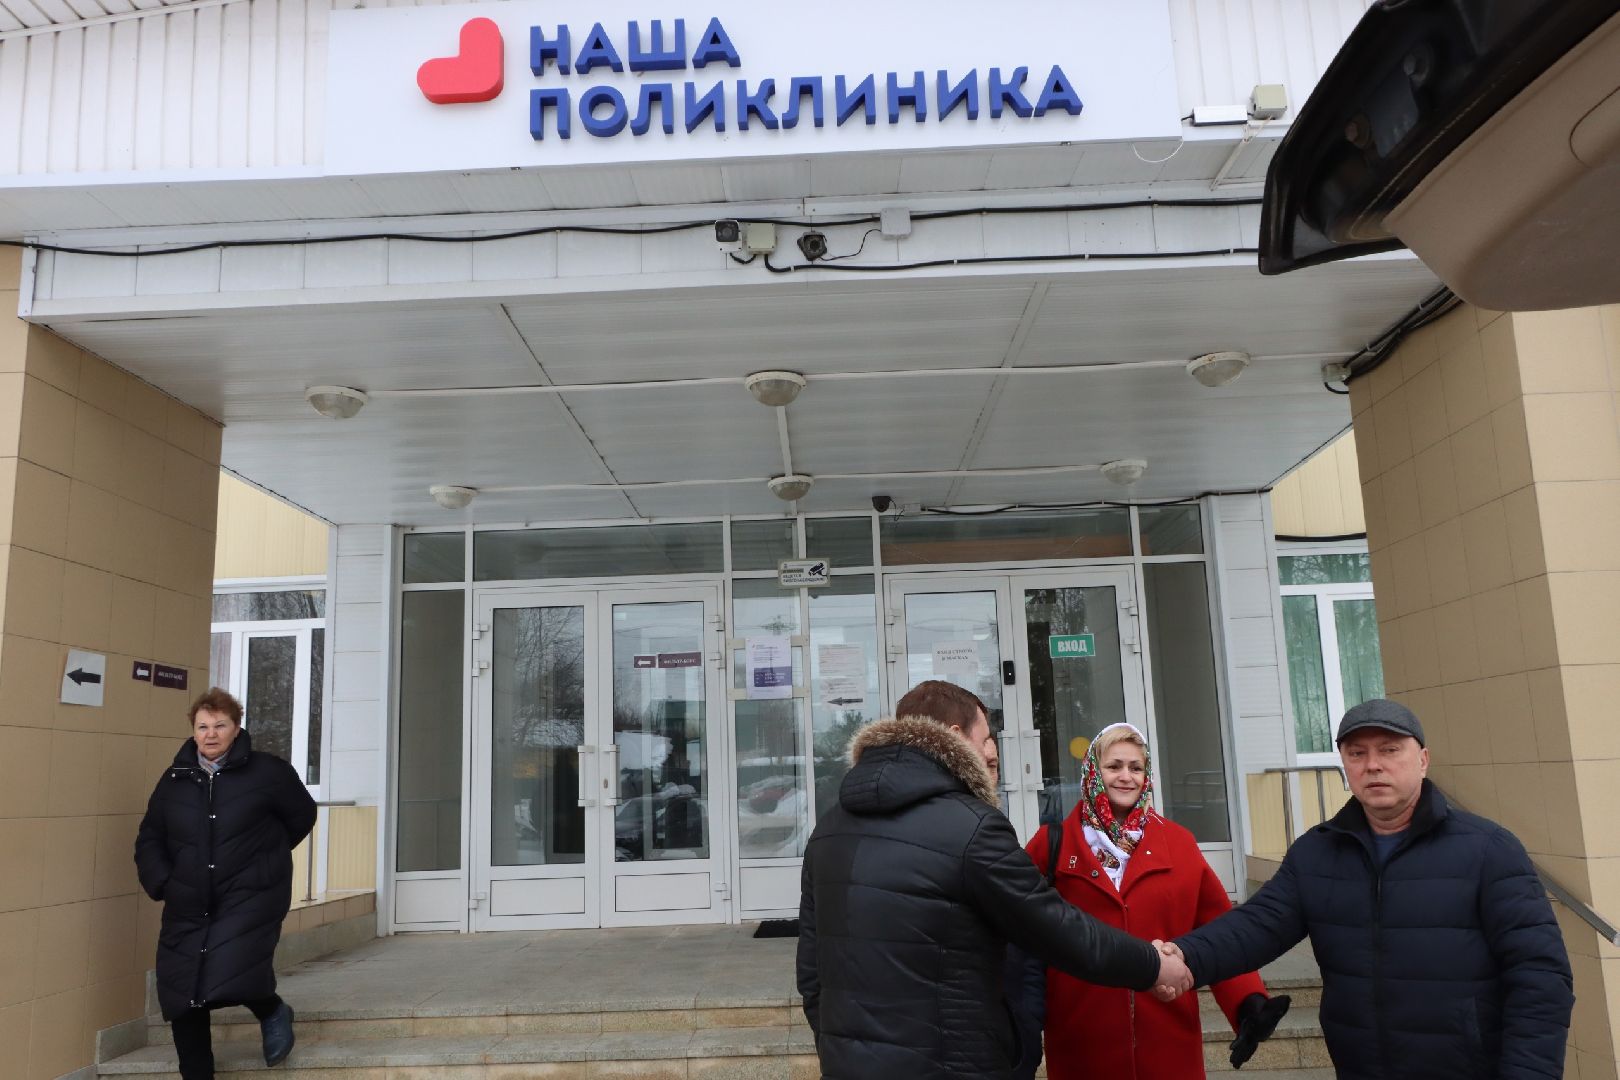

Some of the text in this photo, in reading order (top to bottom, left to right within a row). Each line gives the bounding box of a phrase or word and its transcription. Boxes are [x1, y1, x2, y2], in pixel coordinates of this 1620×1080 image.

[530, 17, 741, 76] НАША
[530, 65, 1083, 140] ПОЛИКЛИНИКА
[1057, 639, 1088, 653] ВХОД
